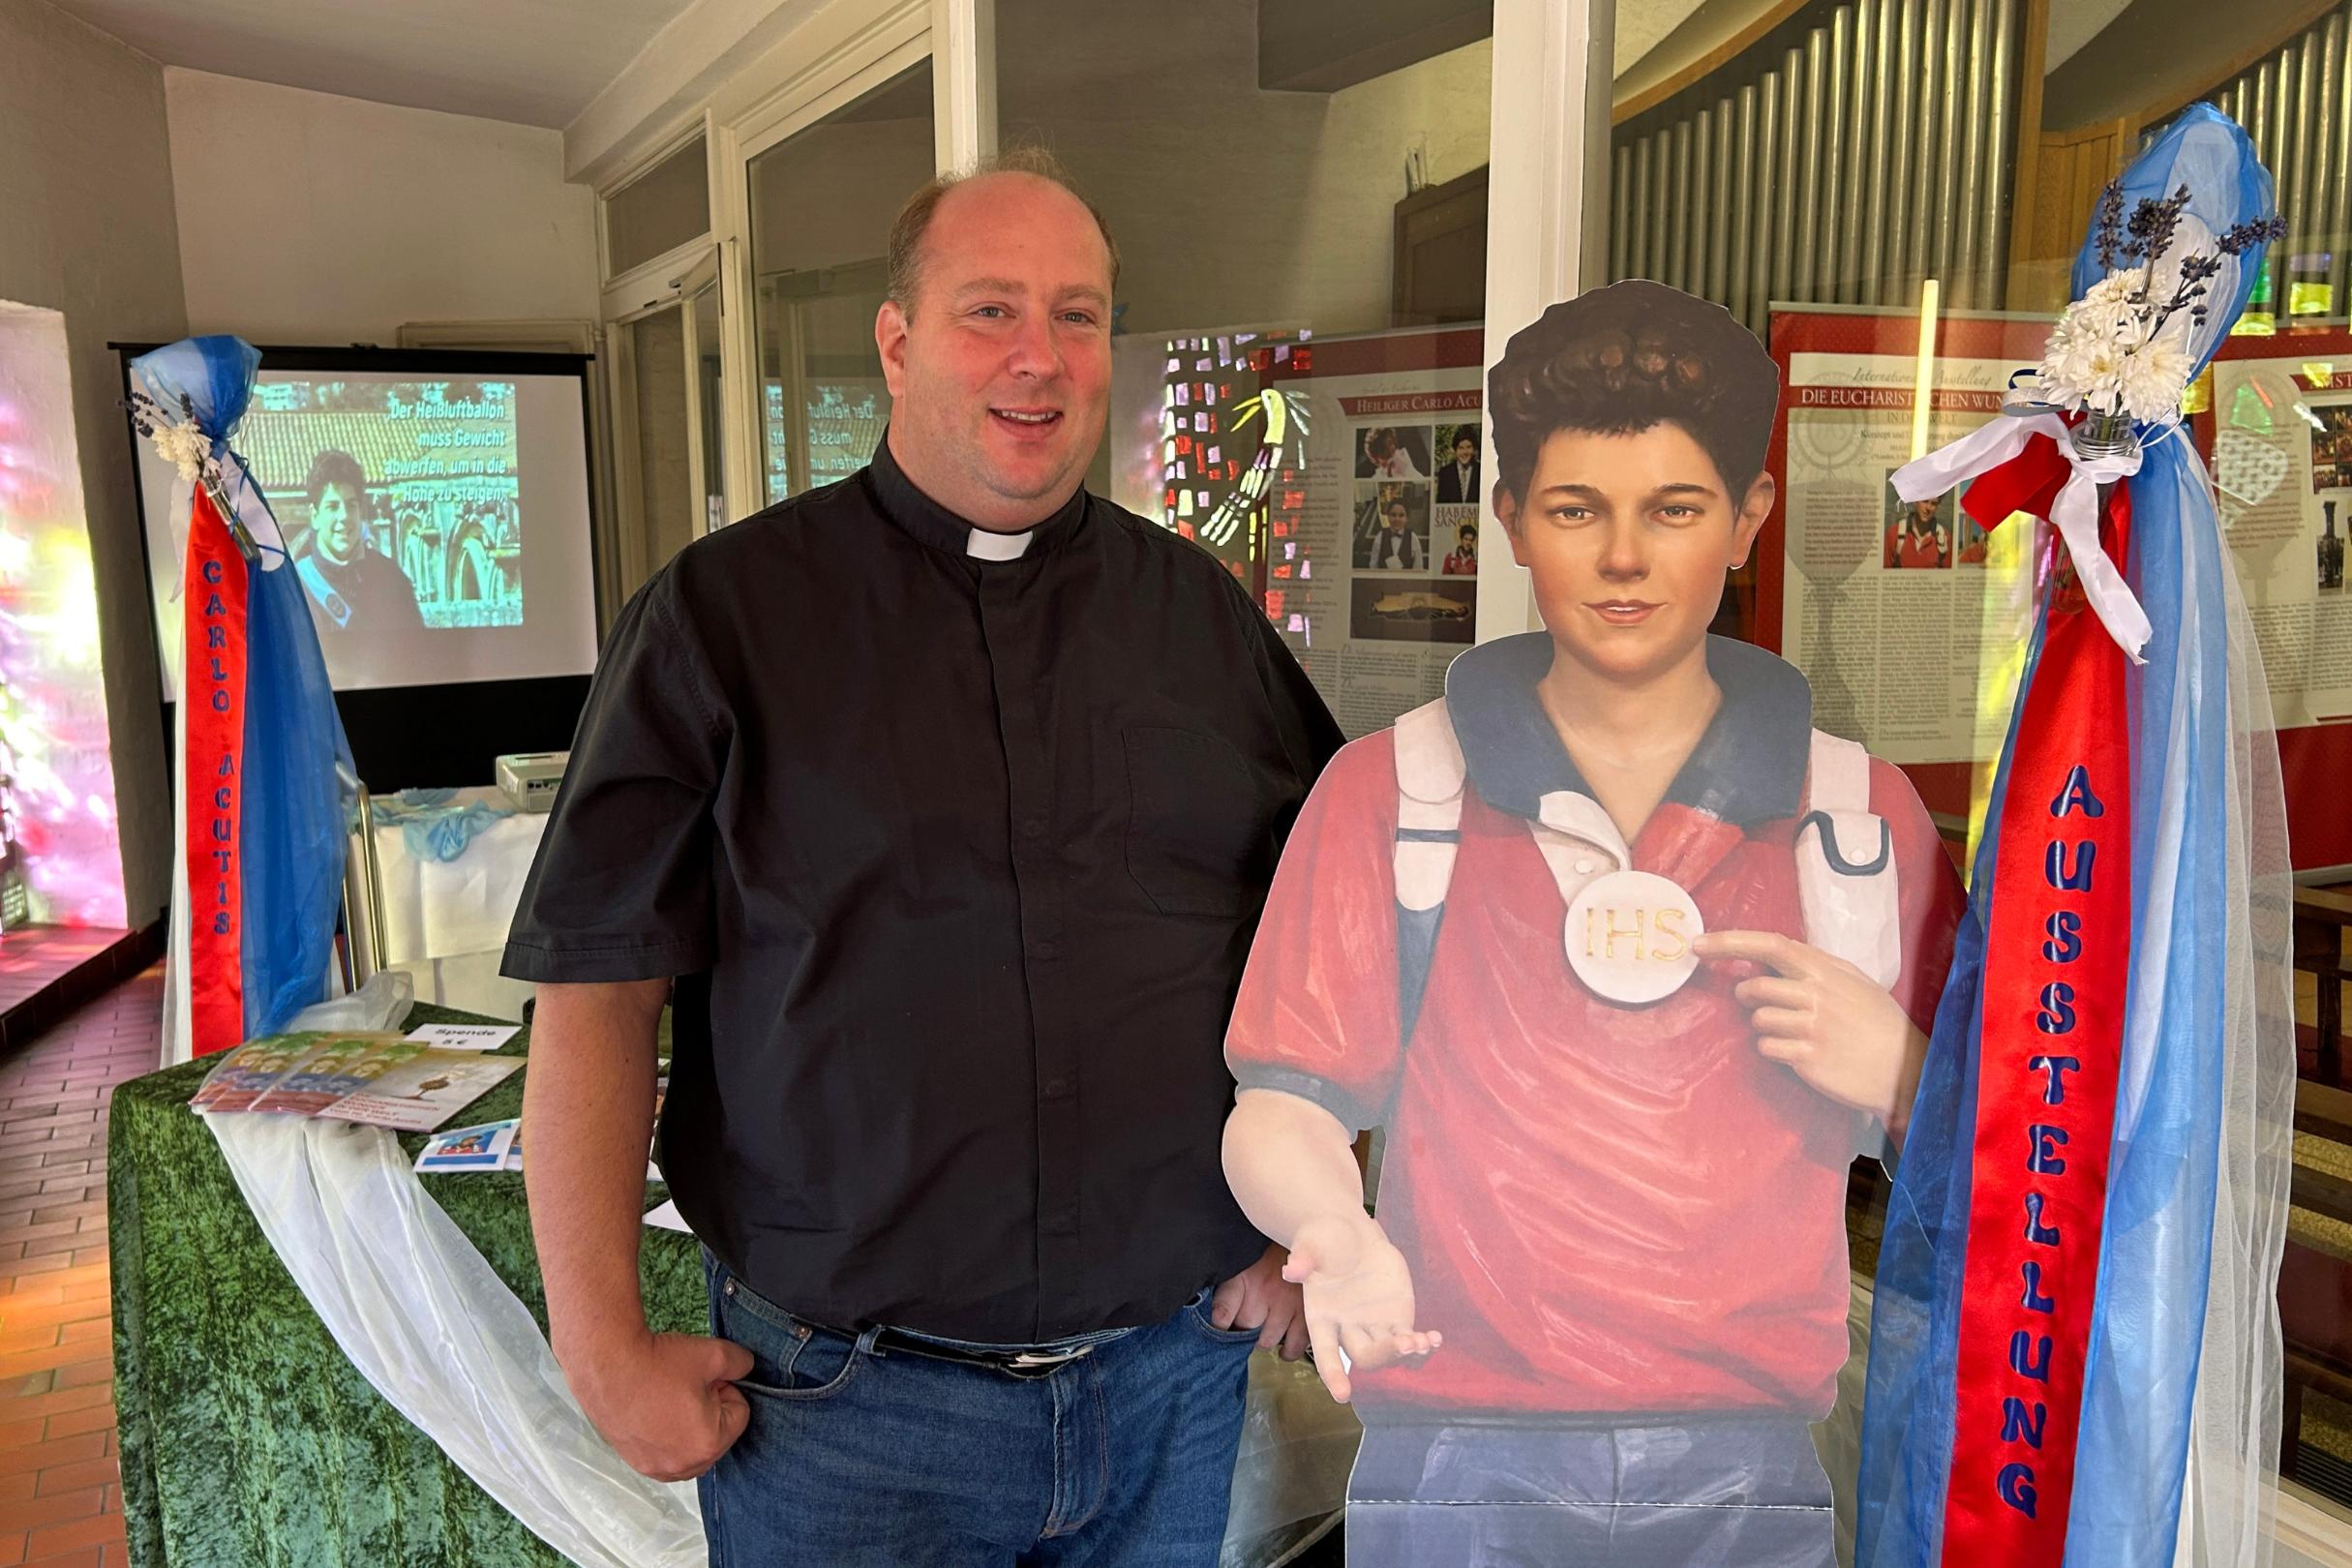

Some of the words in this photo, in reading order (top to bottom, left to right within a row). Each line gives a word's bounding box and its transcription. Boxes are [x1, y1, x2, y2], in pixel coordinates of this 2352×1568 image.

[1411, 395, 1452, 410] CARLO
[1801, 388, 1828, 405] DIE
[389, 402, 413, 418] Der
[415, 400, 504, 418] Heißluftballon
[417, 432, 452, 447] muss
[453, 427, 505, 447] Gewicht
[384, 456, 446, 476] abwerfen,
[448, 460, 468, 473] um
[471, 457, 484, 473] in
[486, 455, 506, 473] die
[437, 489, 452, 502] zu
[202, 560, 230, 712] CARLO
[212, 753, 234, 935] ACUTIS
[1585, 908, 1689, 961] IHS
[1997, 765, 2104, 1520] AUSSTELLUNG
